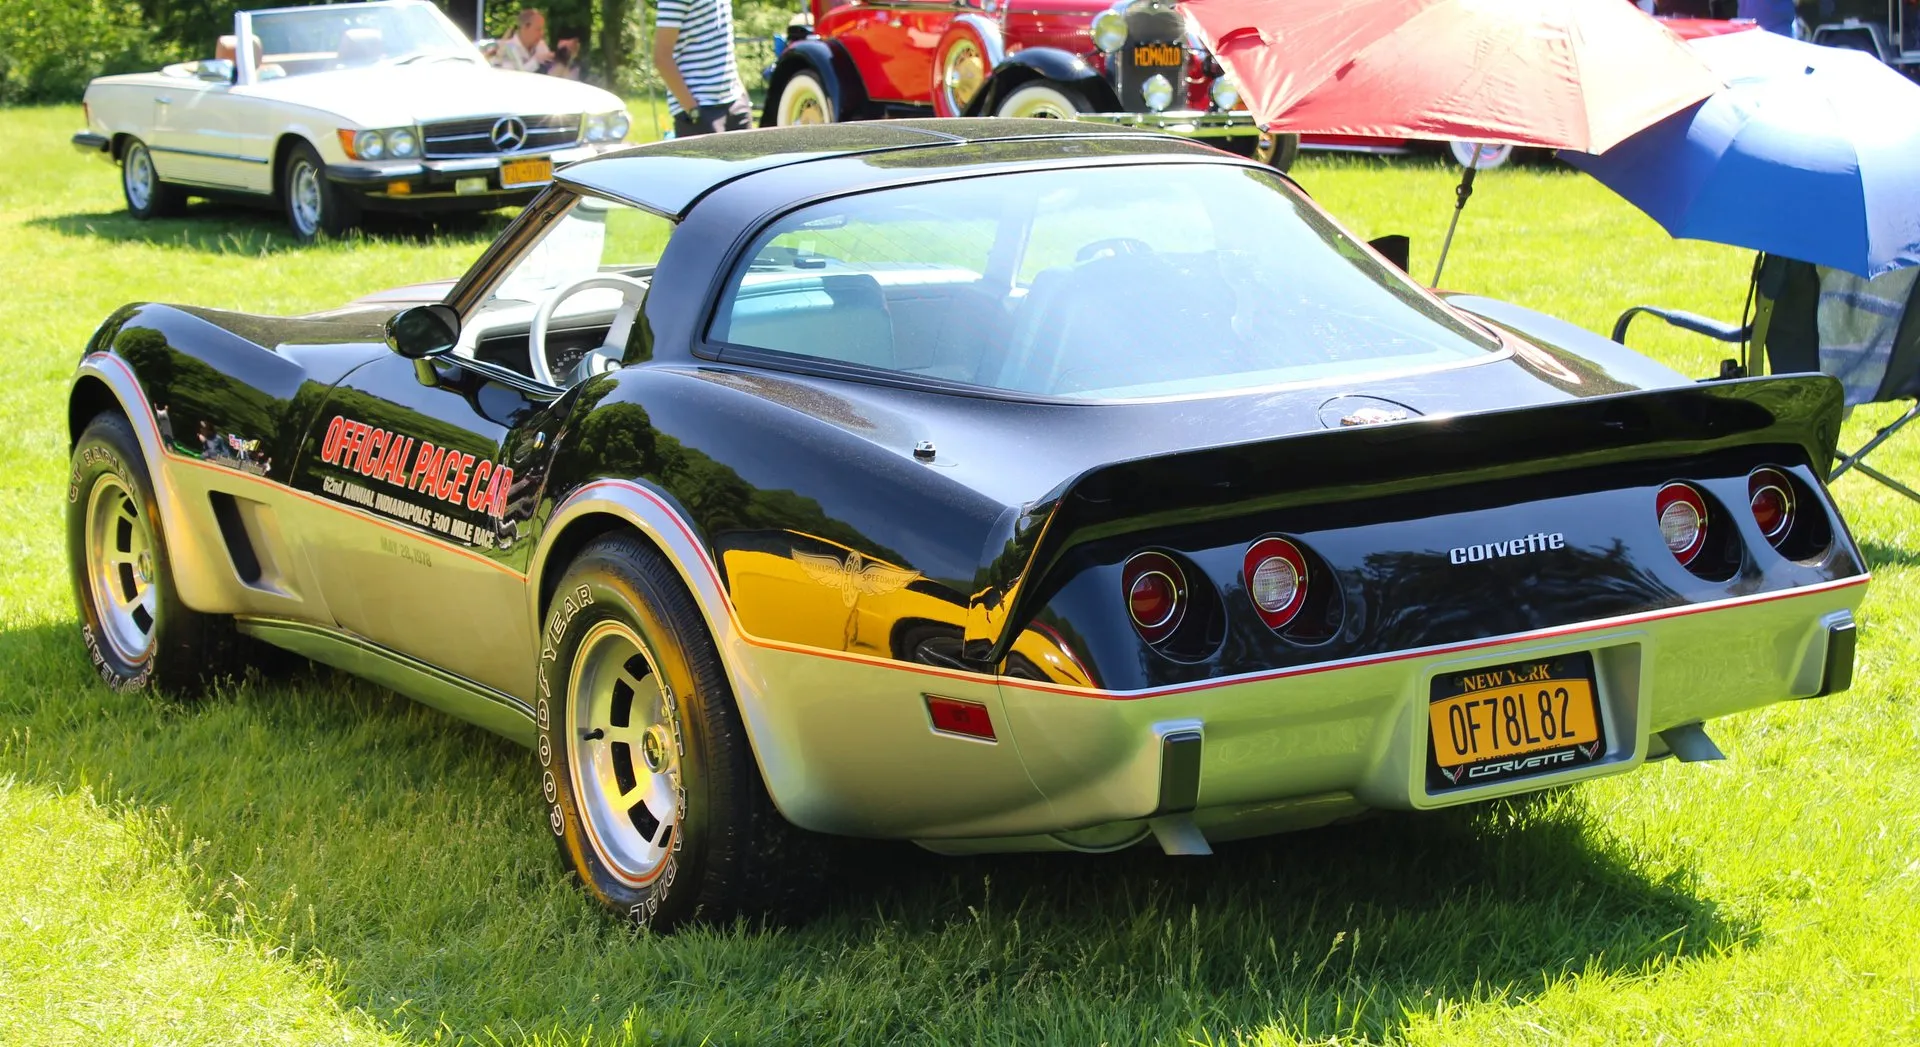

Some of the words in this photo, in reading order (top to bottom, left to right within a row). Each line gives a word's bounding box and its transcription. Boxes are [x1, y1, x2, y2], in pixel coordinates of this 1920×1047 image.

[321, 415, 415, 488] OFFICIAL
[408, 441, 477, 506] PACE
[466, 459, 514, 521] CAR
[322, 476, 344, 496] 62nd
[343, 484, 375, 506] ANNUAL
[375, 492, 431, 527] INDIANAPOLIS
[432, 514, 451, 533] 500
[451, 518, 473, 542] MILE
[472, 527, 496, 550] RACE
[1450, 532, 1565, 565] corvette
[1463, 672, 1503, 692] NEW
[1469, 750, 1576, 778] CORVETTE
